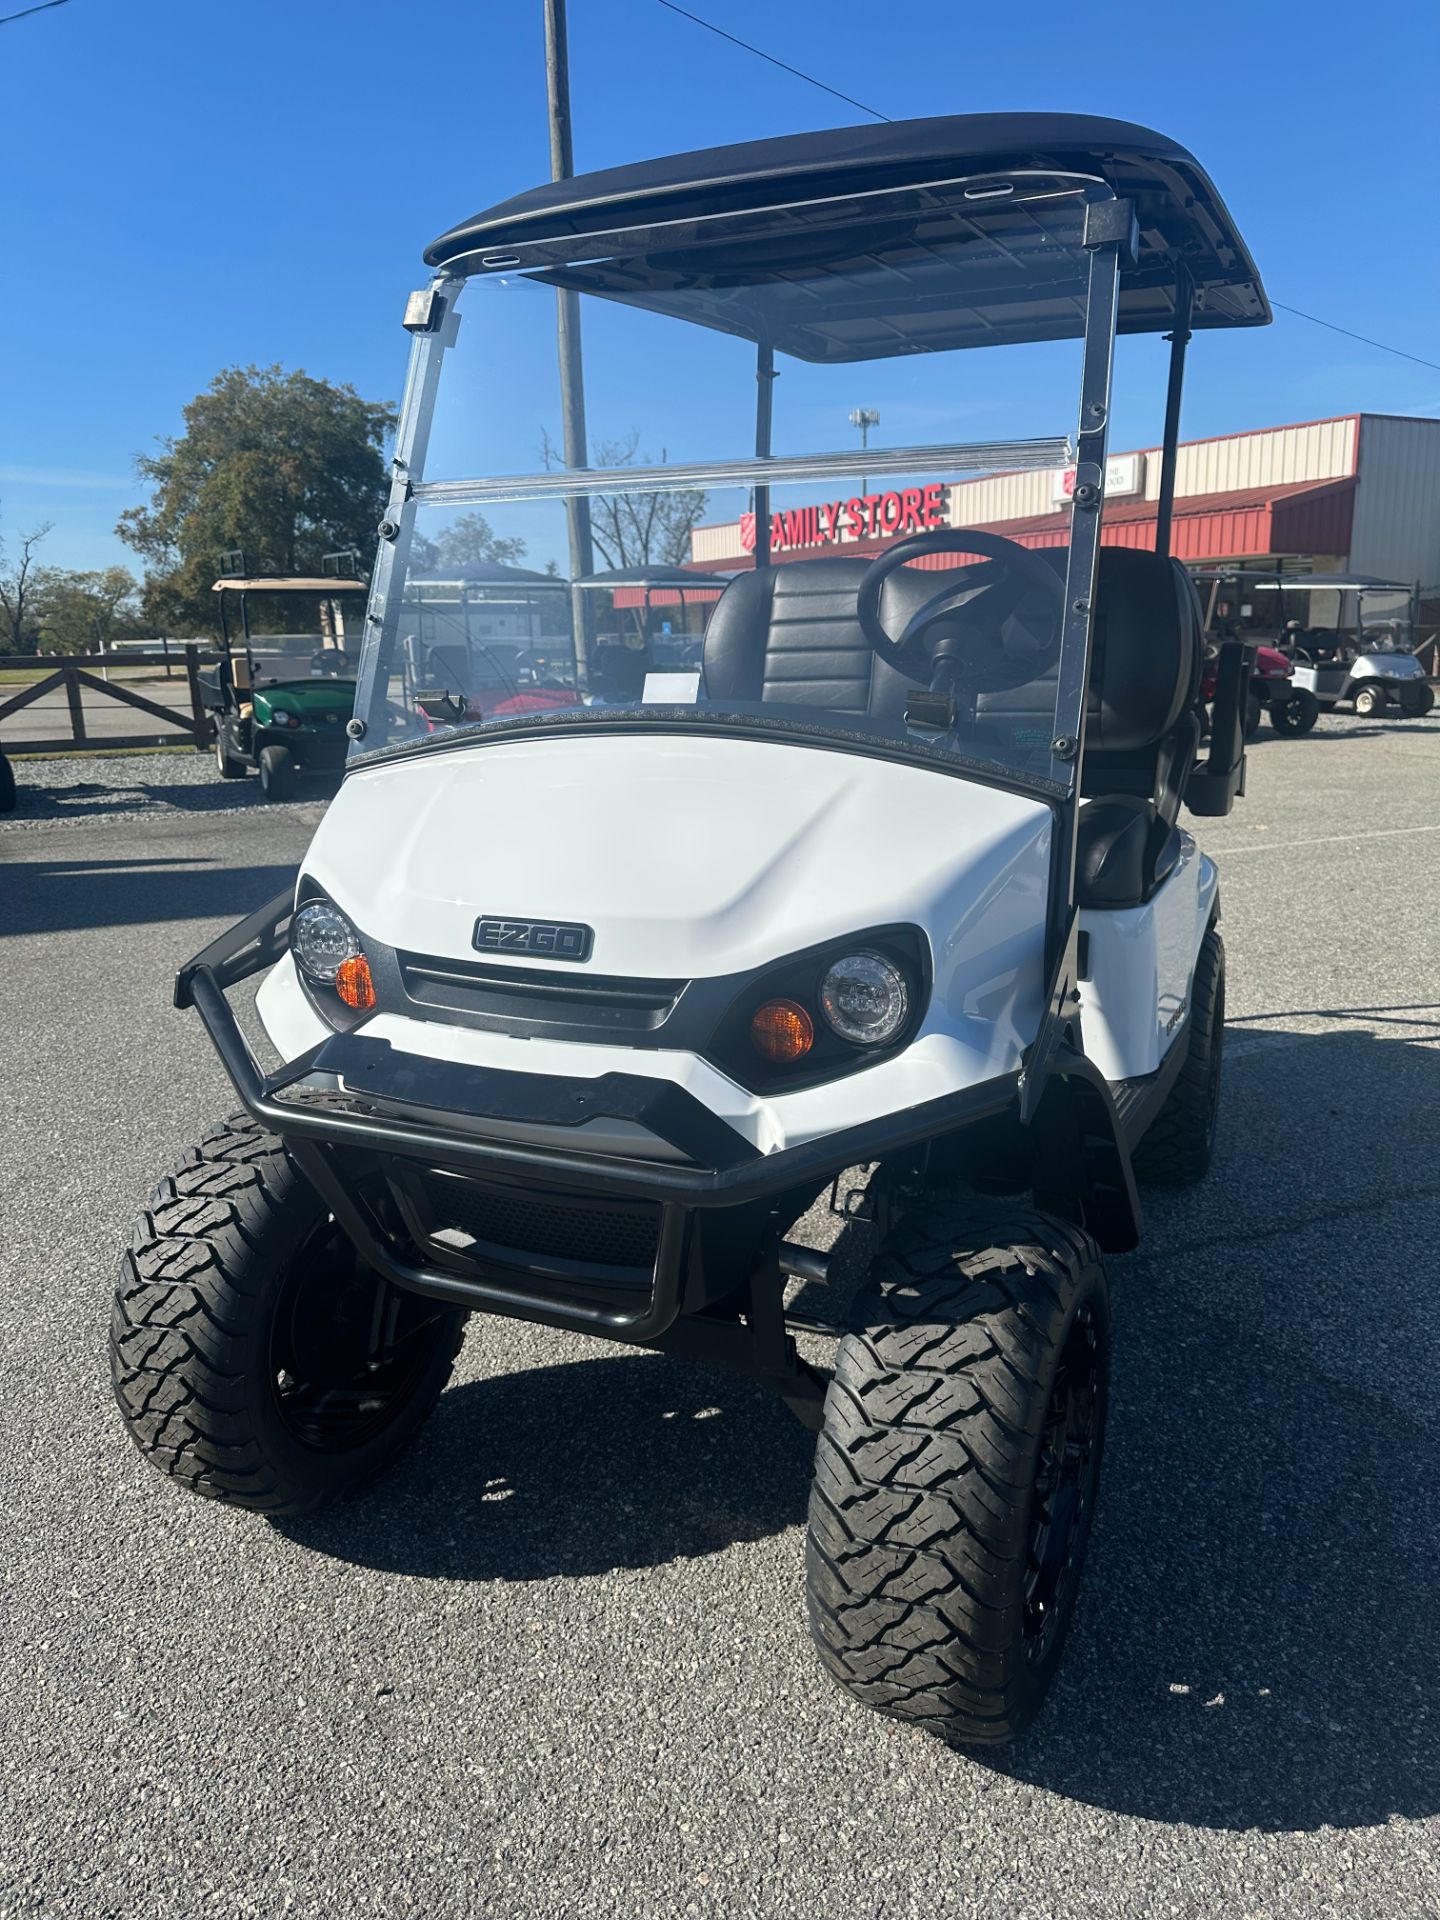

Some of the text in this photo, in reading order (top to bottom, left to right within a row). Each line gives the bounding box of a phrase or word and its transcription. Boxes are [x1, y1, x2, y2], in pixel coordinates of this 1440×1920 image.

[768, 483, 944, 548] AMILY STORE
[477, 919, 584, 956] EZGO
